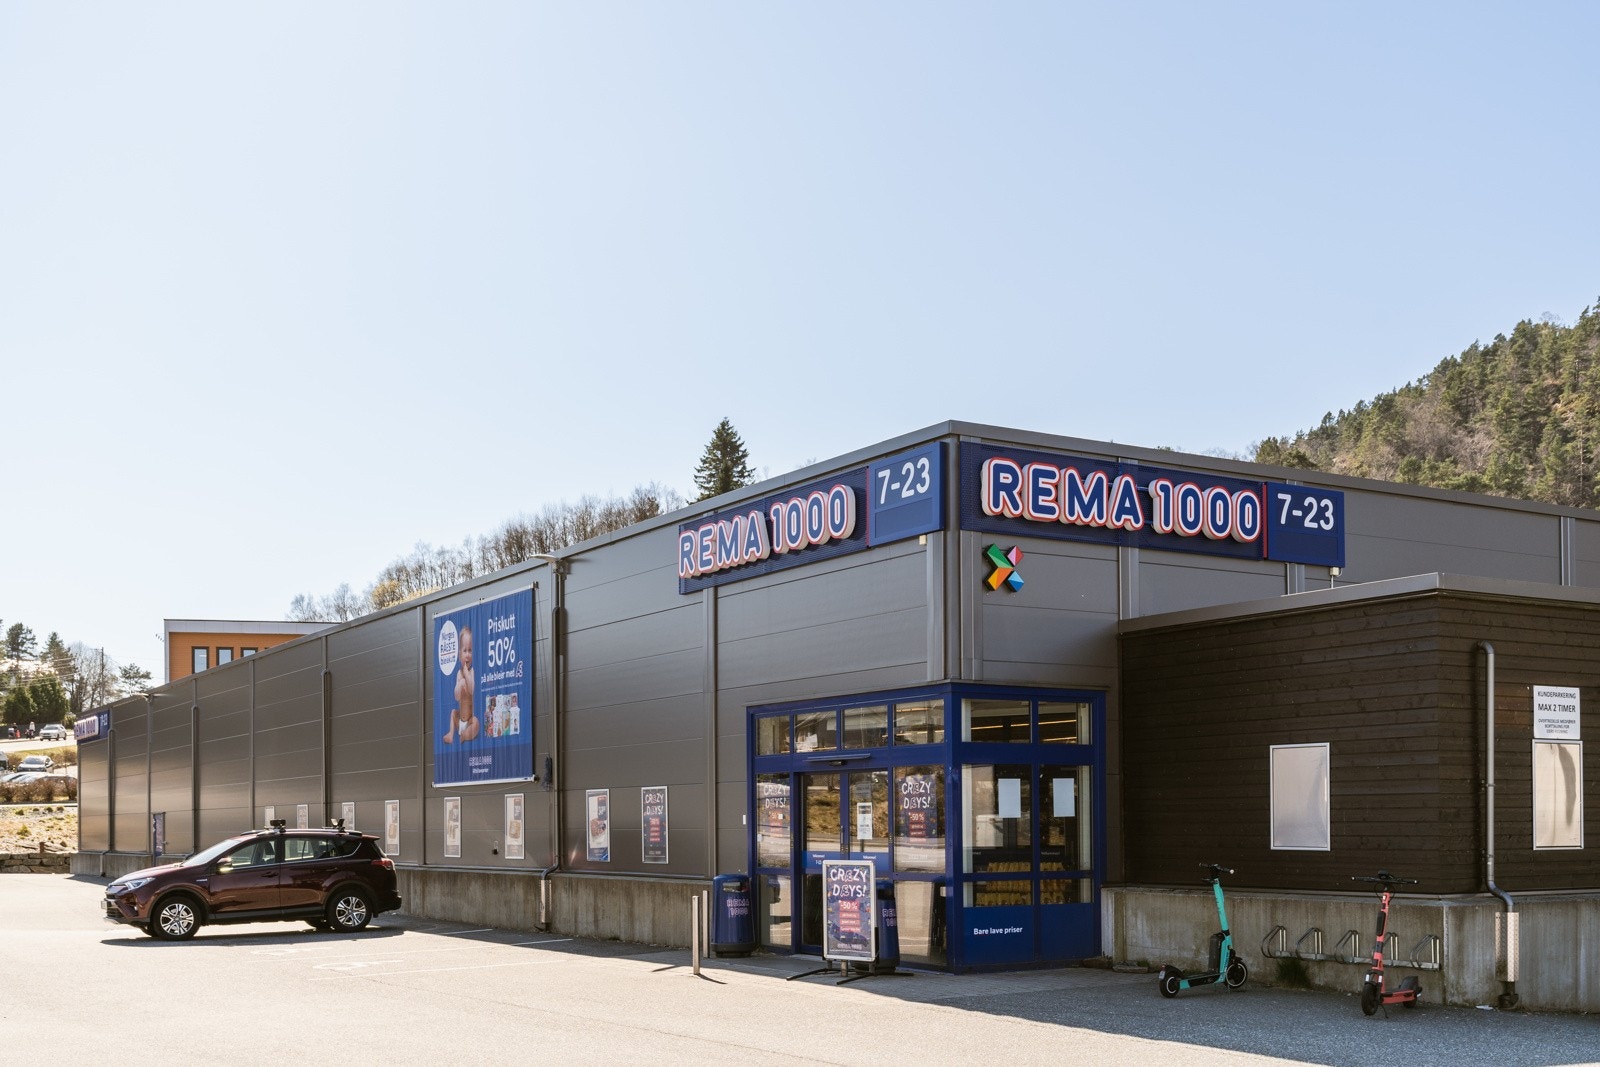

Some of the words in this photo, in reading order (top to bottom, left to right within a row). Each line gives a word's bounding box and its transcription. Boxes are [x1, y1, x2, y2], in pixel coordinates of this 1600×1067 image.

[877, 457, 931, 505] 7-23
[981, 457, 1145, 531] REMA
[1149, 478, 1261, 543] 1000
[1277, 493, 1334, 530] 7-23
[678, 510, 770, 579] REMA
[770, 484, 856, 554] 1000
[488, 613, 515, 634] Priskutt
[488, 636, 515, 667] 50%
[1538, 703, 1552, 711] MAX
[1553, 704, 1557, 712] 2
[1558, 704, 1576, 712] TIMER
[973, 927, 989, 935] Bare
[1004, 926, 1023, 935] priser
